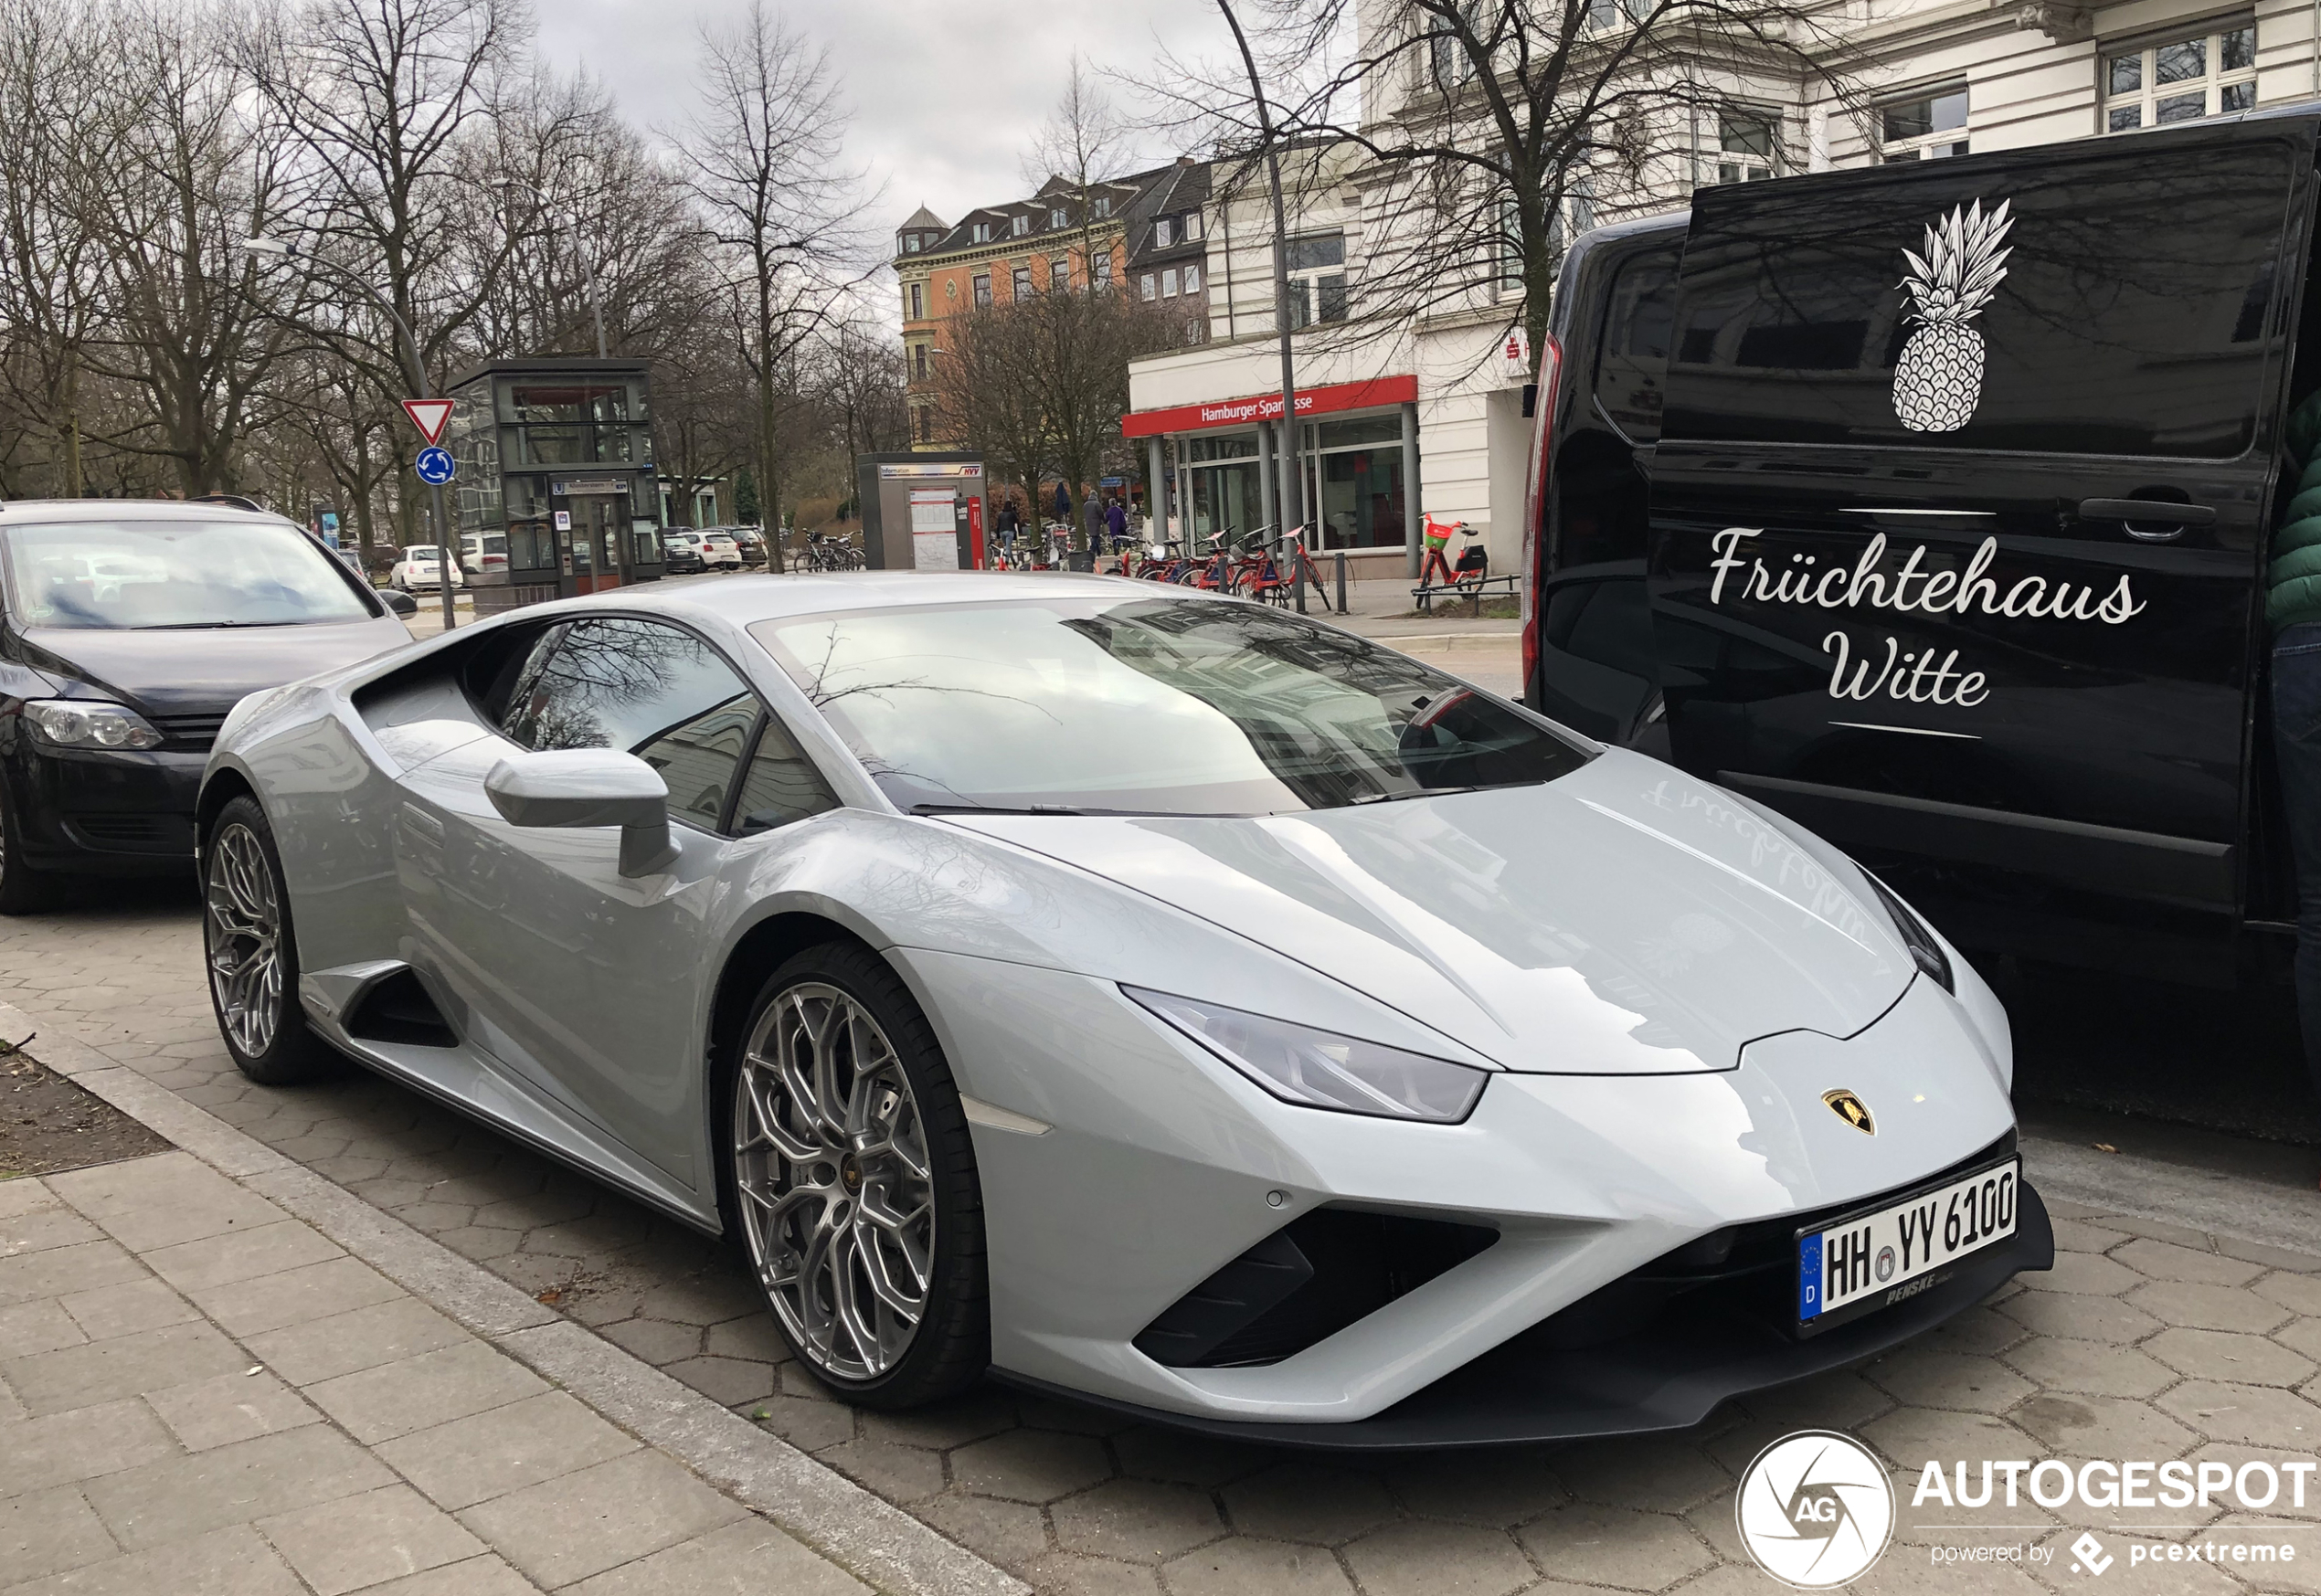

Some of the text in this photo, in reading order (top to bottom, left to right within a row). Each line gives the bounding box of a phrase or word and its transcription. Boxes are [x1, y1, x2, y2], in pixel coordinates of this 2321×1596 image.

[1202, 396, 1312, 421] Hamburger Sparsse
[964, 467, 980, 476] HVV
[1710, 527, 2146, 625] Früchtehaus
[1822, 630, 1990, 707] Witte
[1827, 1171, 2013, 1302] HH YY 6100
[1806, 1284, 1815, 1304] D
[1886, 1274, 1935, 1305] PENSKE
